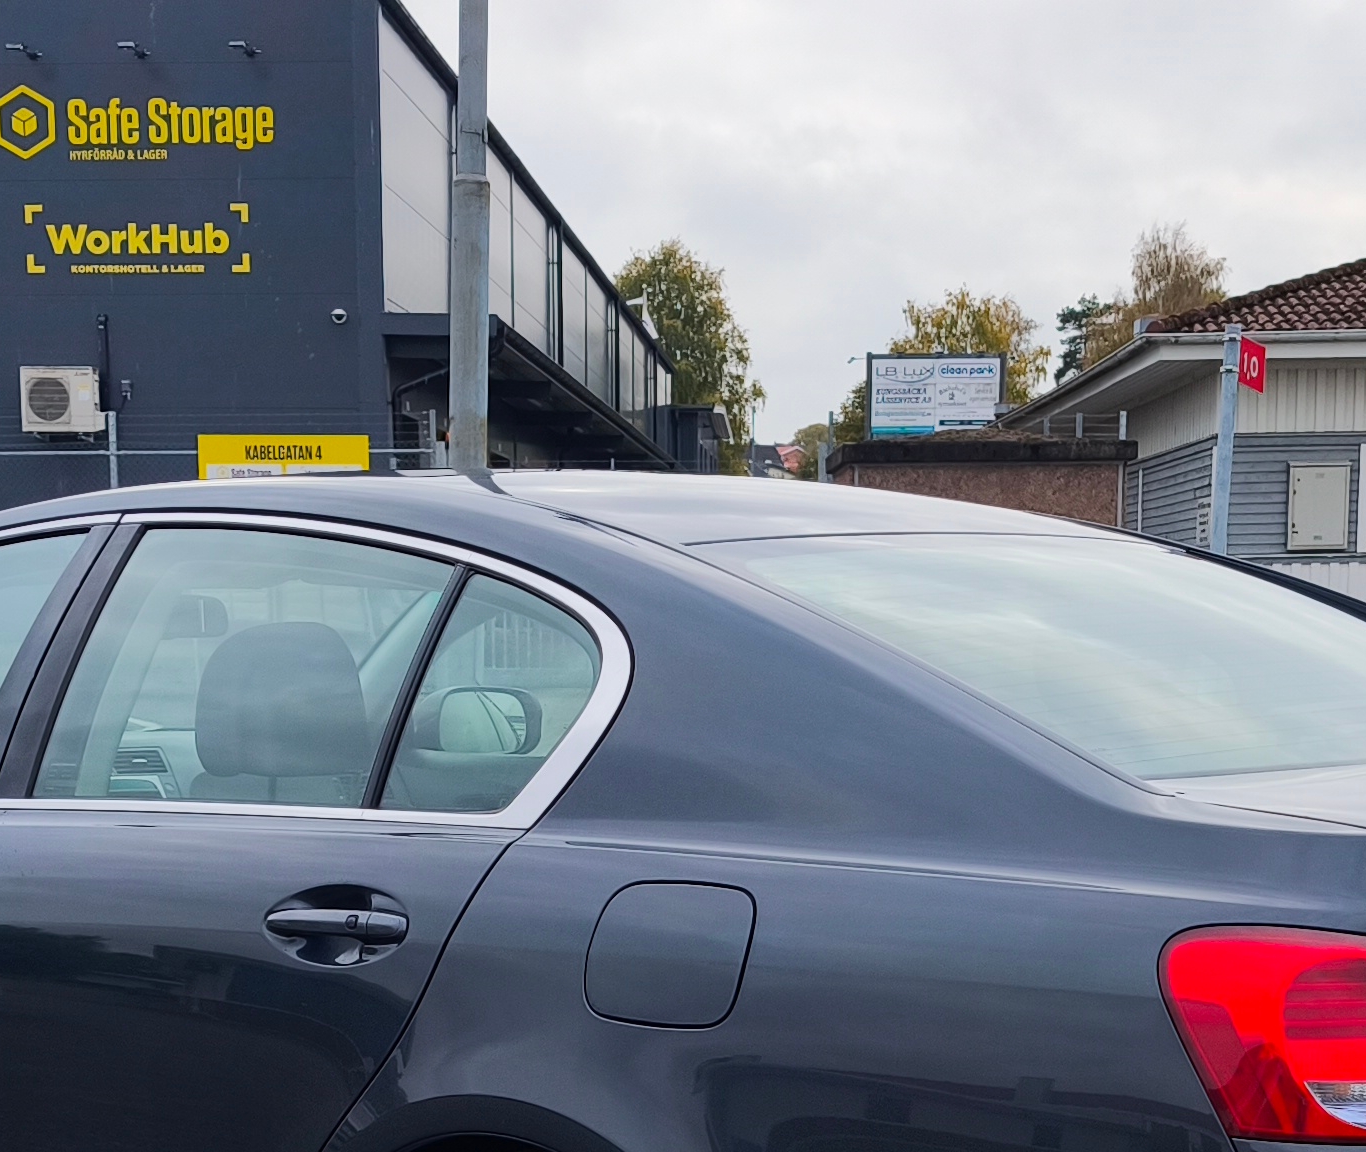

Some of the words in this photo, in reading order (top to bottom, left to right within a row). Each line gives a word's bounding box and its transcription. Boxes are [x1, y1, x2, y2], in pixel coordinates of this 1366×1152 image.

[67, 98, 139, 145] Safe
[147, 98, 274, 150] Storage
[69, 148, 125, 161] HYRFÖRRÅD
[127, 150, 135, 160] &
[137, 150, 168, 160] LAGER
[45, 222, 230, 255] WorkHub
[71, 264, 160, 274] KONTORSHOTELL
[161, 265, 169, 273] &
[170, 264, 205, 273] LAGER
[940, 365, 968, 375] clean
[969, 365, 995, 376] park
[245, 444, 313, 461] KABELGATAN
[314, 445, 323, 461] 4
